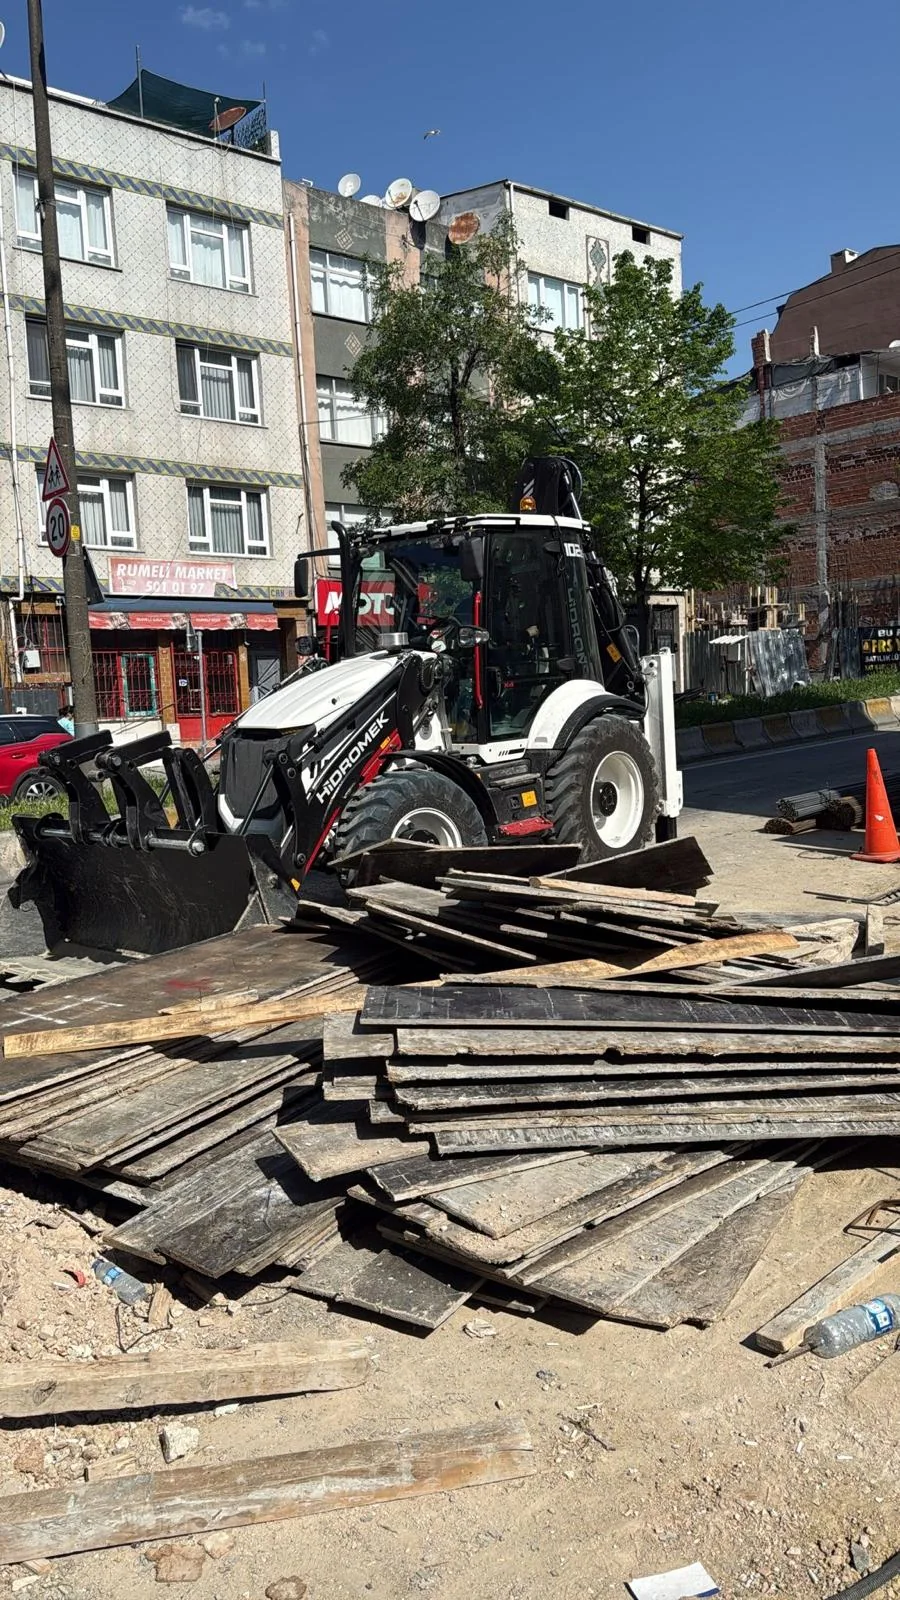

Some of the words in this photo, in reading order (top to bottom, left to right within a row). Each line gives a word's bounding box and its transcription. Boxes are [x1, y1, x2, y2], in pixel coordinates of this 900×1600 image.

[50, 512, 65, 541] 20
[174, 565, 229, 581] MARKET
[145, 580, 167, 593] 501
[172, 581, 185, 593] 01
[190, 582, 205, 594] 97
[877, 629, 893, 637] BU
